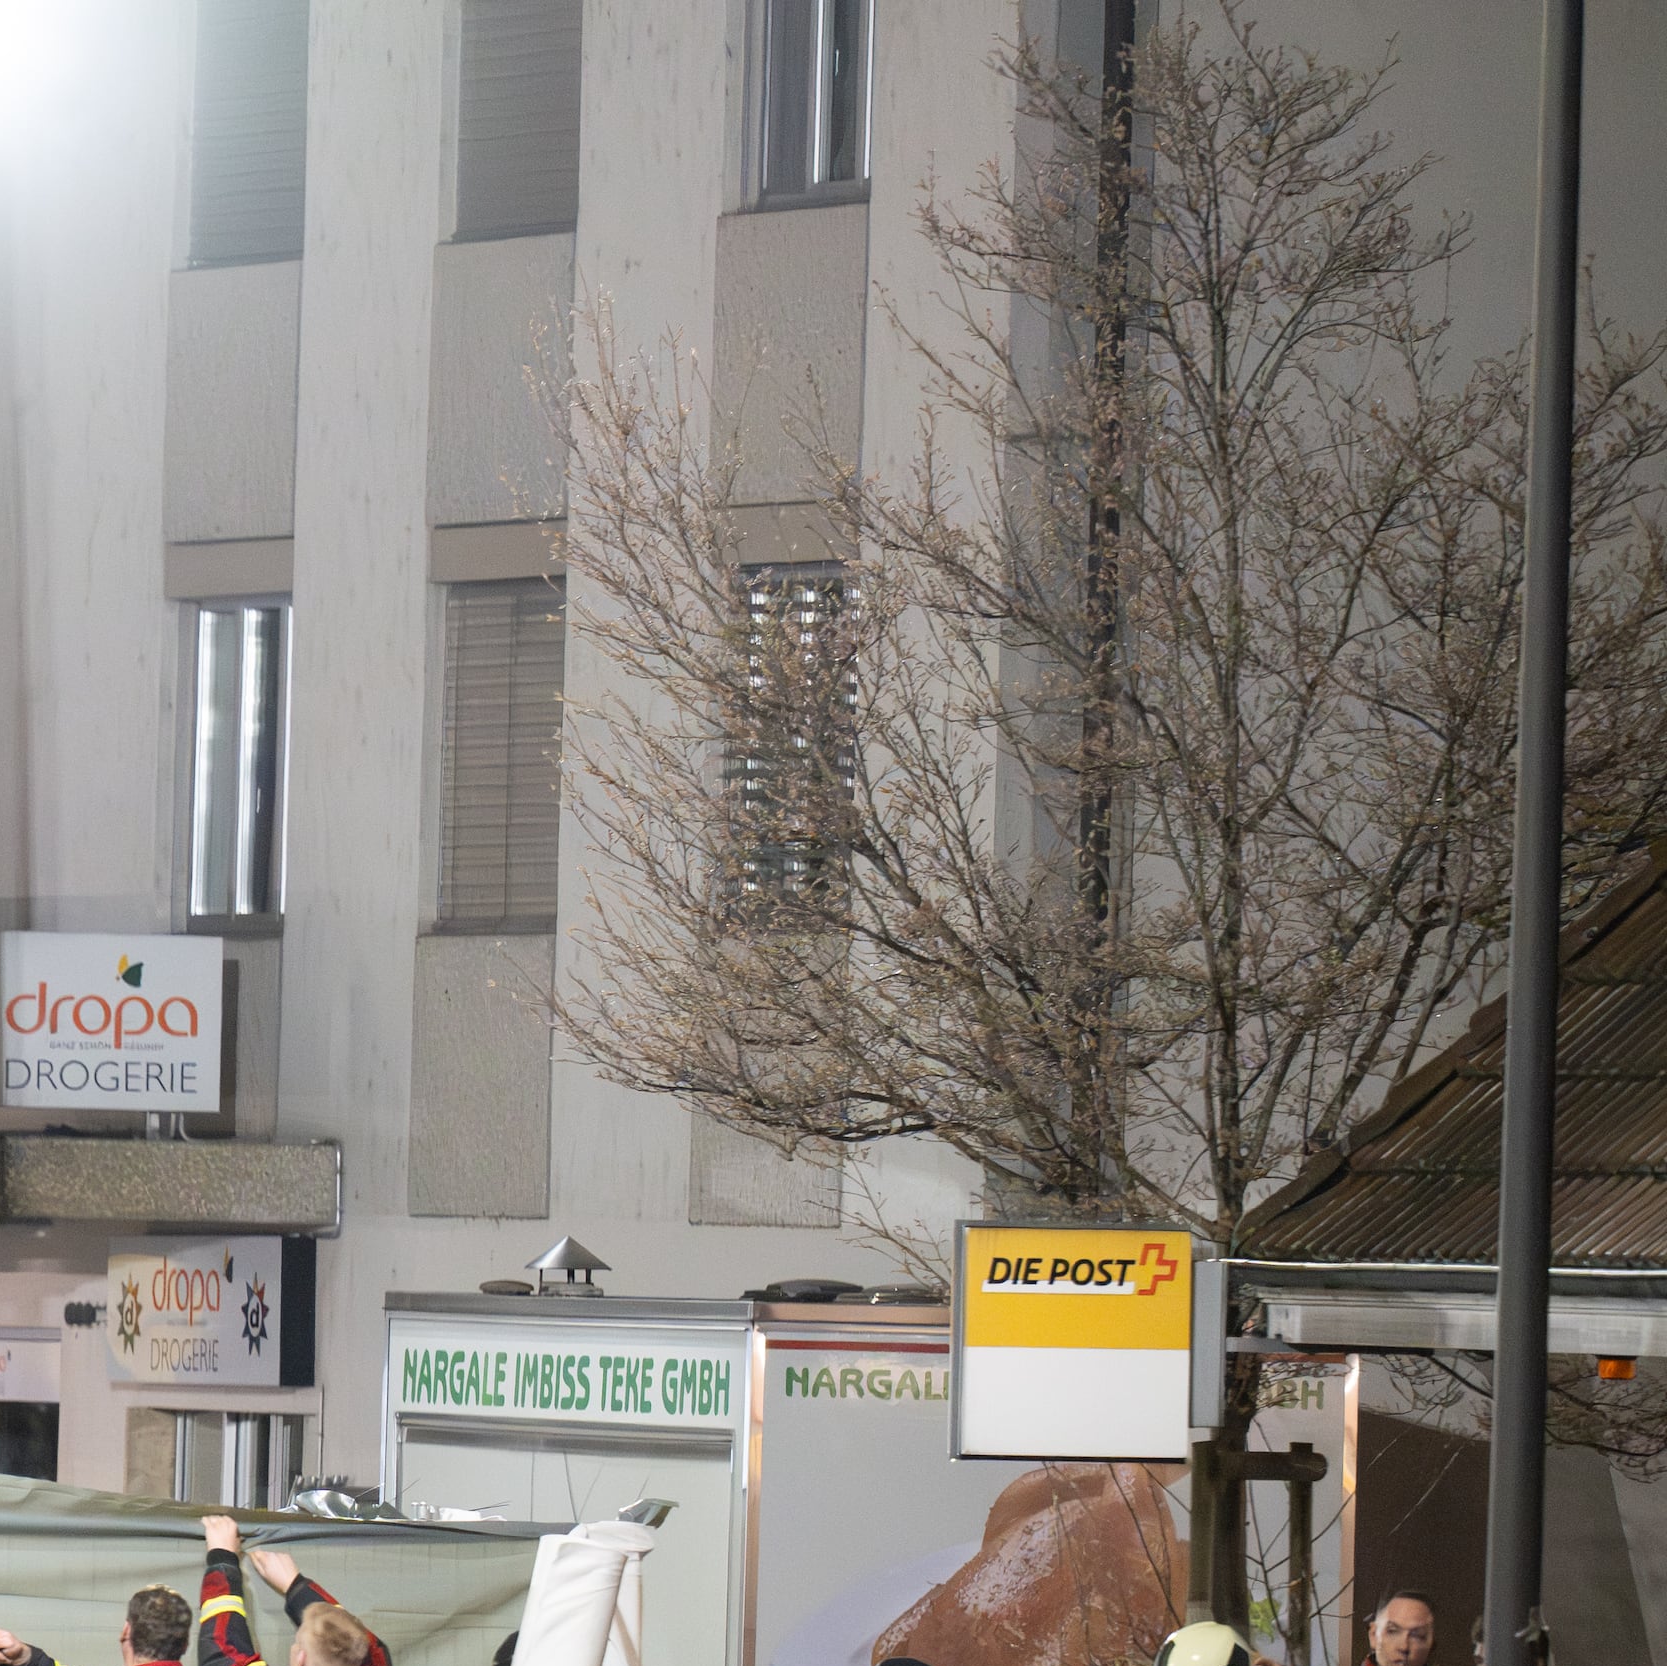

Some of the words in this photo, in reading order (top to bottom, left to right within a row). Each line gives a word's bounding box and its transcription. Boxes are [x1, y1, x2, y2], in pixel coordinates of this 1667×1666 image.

[5, 981, 199, 1050] dropa
[5, 1058, 198, 1094] DROGERIE
[987, 1257, 1043, 1285] DIE
[1048, 1258, 1136, 1286] POST
[152, 1255, 221, 1327] dropa
[250, 1302, 260, 1329] d
[150, 1338, 220, 1372] DROGERIE
[402, 1348, 507, 1407] NARGALE
[514, 1353, 590, 1411] IMBISS
[599, 1356, 654, 1413] TEKE
[662, 1358, 730, 1416] GMBH
